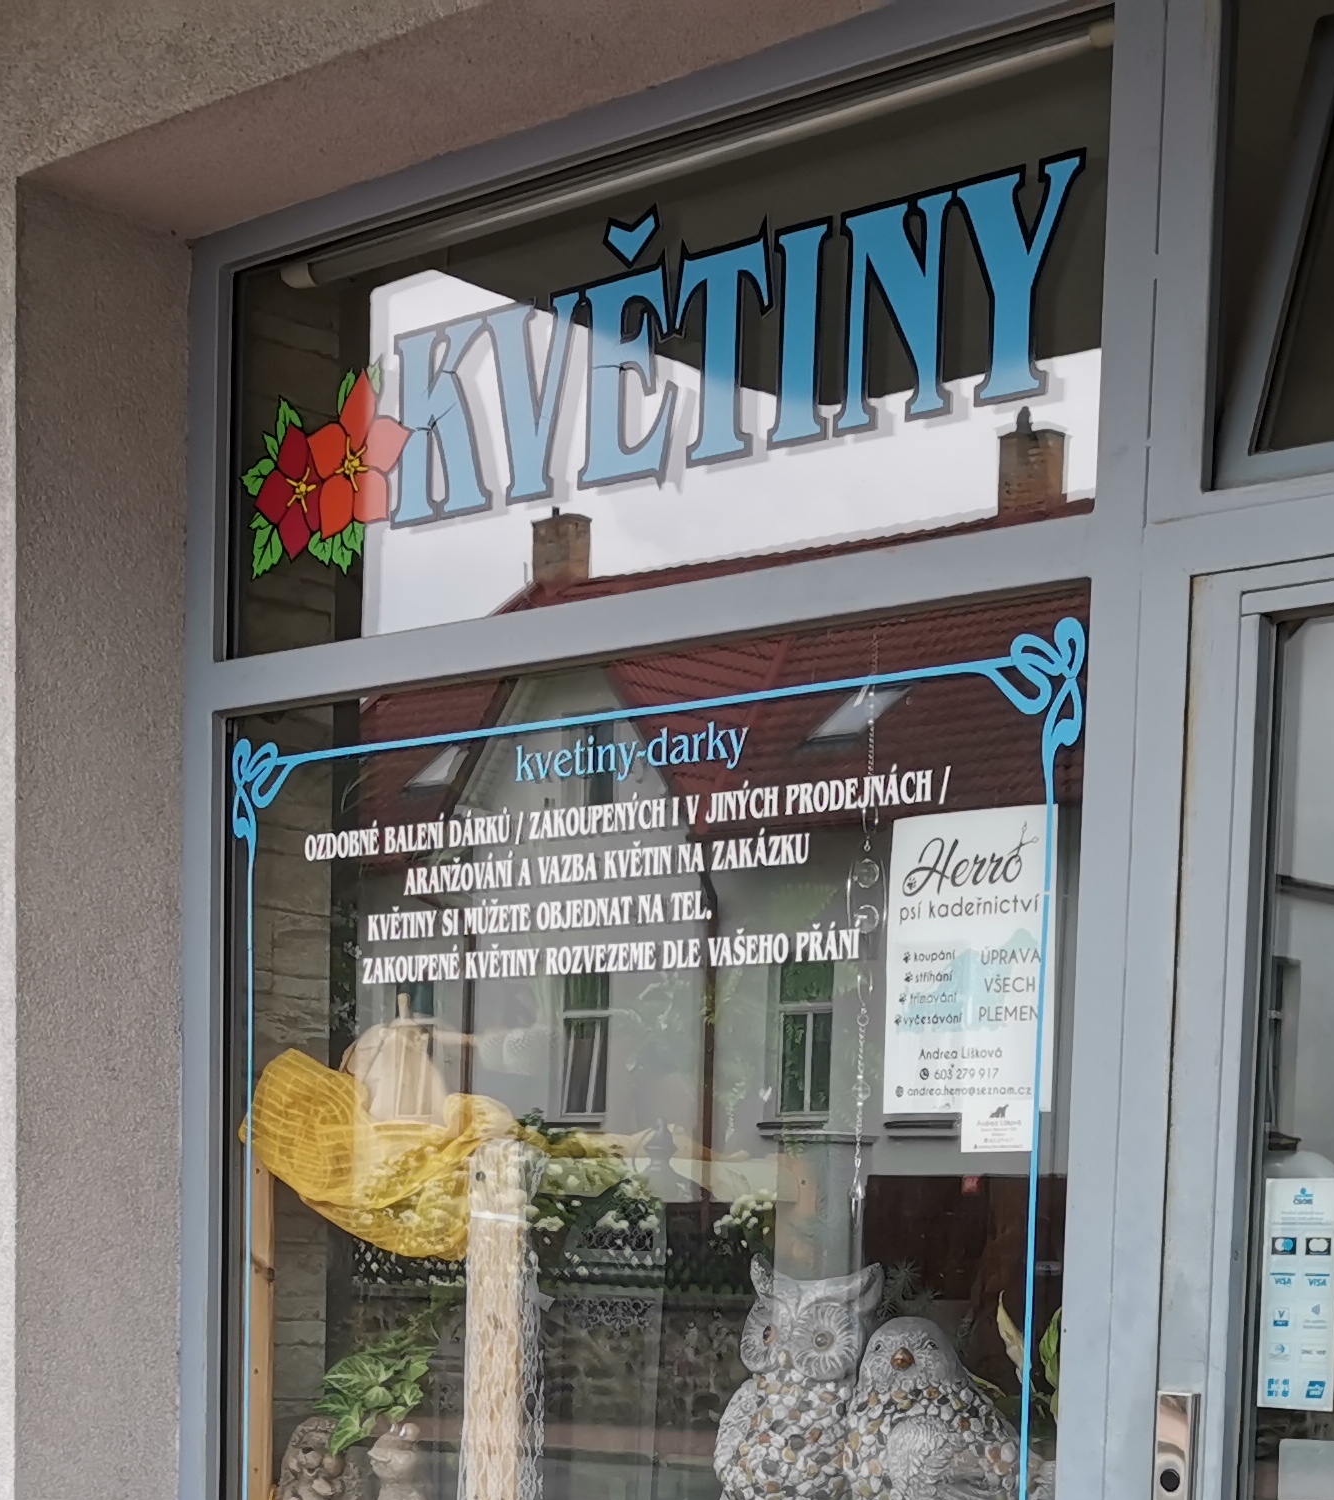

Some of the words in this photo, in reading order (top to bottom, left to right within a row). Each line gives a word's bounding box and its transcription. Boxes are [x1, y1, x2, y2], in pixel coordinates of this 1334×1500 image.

[390, 148, 1087, 527] KVĚTINY
[515, 722, 749, 782] kvetiny-darky
[304, 820, 380, 862] OZDOBNÉ
[384, 812, 445, 855] BALENÍ
[449, 806, 511, 849] DÁRKŮ
[529, 792, 666, 840] ZAKOUPENÝCH
[671, 796, 679, 826] I
[685, 794, 700, 825] V
[705, 780, 779, 824] JINÝCH
[785, 763, 933, 816] PRODEJNÁCH
[403, 851, 514, 896] ARANŽOVÁNÍ
[517, 857, 531, 887] A
[537, 852, 598, 885] VAZBA
[603, 840, 672, 880] KVĚTIN
[677, 841, 704, 873] NA
[711, 827, 810, 872] ZAKÁZKU
[367, 905, 437, 942] KVĚTINY
[442, 908, 459, 937] SI
[463, 898, 531, 935] MŮŽETE
[536, 896, 633, 930] OBJEDNAT
[638, 893, 665, 923] NA
[670, 890, 712, 921] TEL.
[899, 901, 922, 926] psí
[928, 893, 1040, 919] kadeřnictví
[362, 944, 461, 985] ZAKOUPENÉ
[465, 943, 540, 980] KVĚTINY
[545, 941, 657, 976] ROZVEZEME
[662, 938, 701, 970] DLE
[707, 927, 788, 967] VAŠEHO
[794, 920, 862, 963] PŘÁNÍ
[913, 950, 956, 963] koupání
[980, 947, 1042, 966] ÚPRAVA
[984, 974, 1036, 993] VŠECH
[978, 1005, 1039, 1022] PLEMEN
[918, 1048, 958, 1060] Andrea
[934, 1068, 953, 1080] 603
[978, 1067, 1000, 1079] 917
